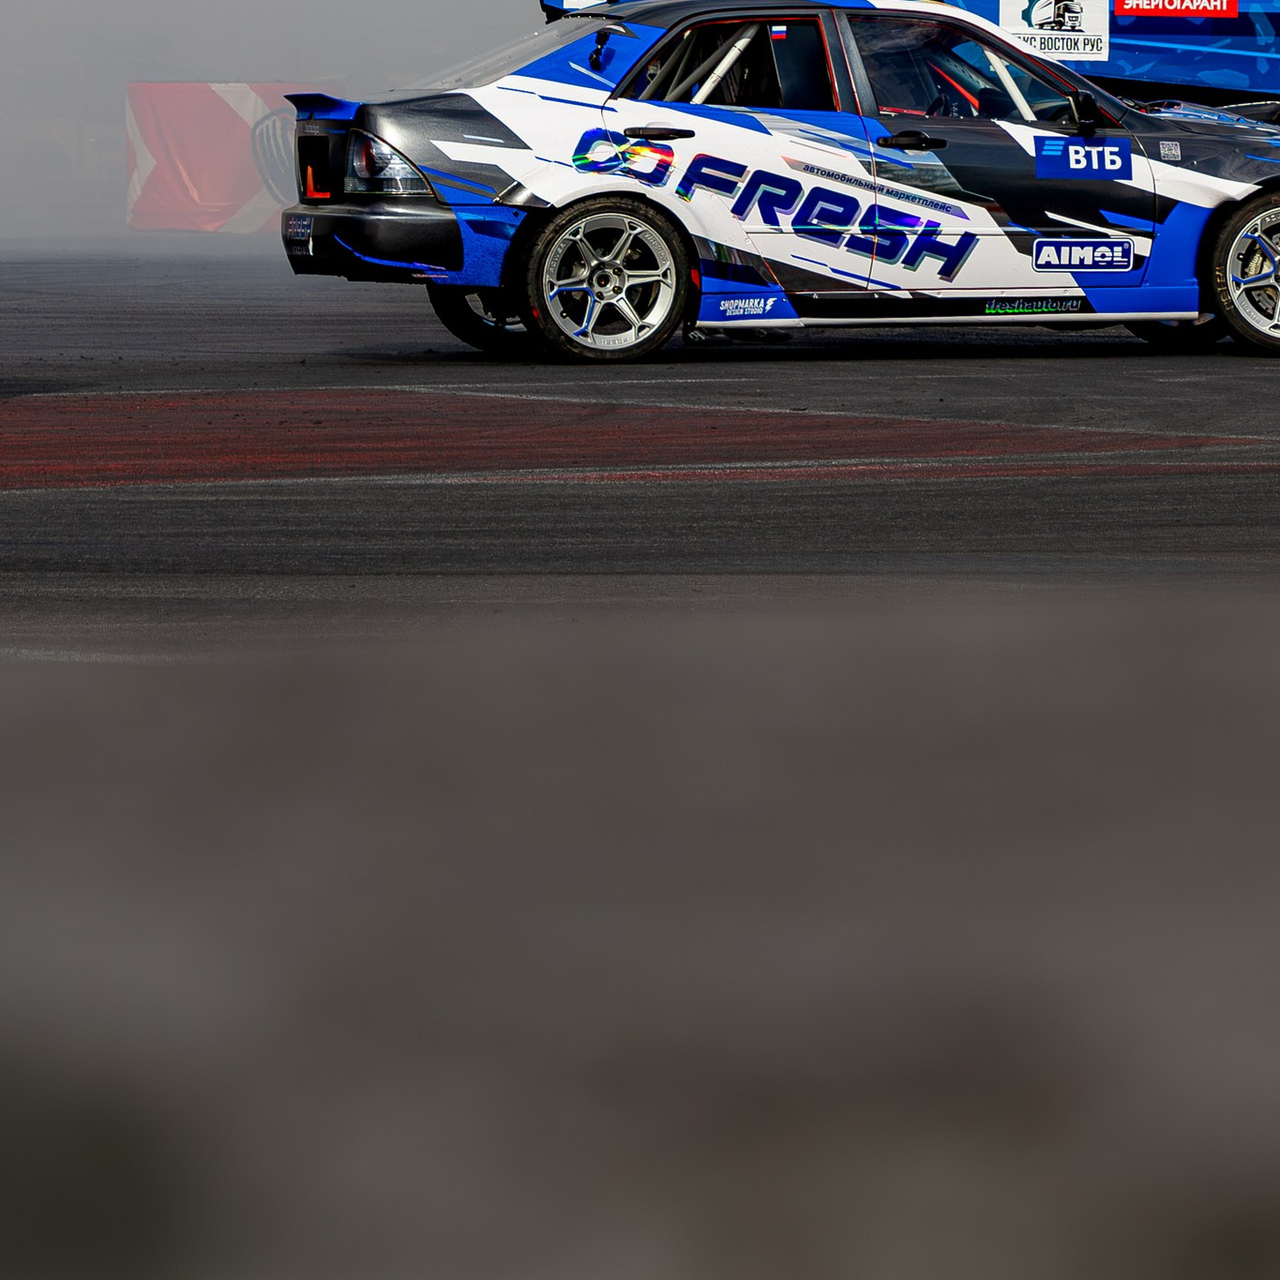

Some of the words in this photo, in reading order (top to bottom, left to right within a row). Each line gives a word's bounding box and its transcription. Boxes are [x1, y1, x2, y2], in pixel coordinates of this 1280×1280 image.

[1039, 36, 1080, 51] ВОСТОК
[1083, 37, 1104, 52] РУС
[1068, 144, 1123, 170] ВТБ
[802, 163, 885, 193] автомобильный
[885, 187, 953, 213] маркетплейс
[1036, 246, 1130, 266] AIMOL
[719, 297, 765, 310] SHOPMARKA
[984, 298, 1082, 314] freshauto.ru
